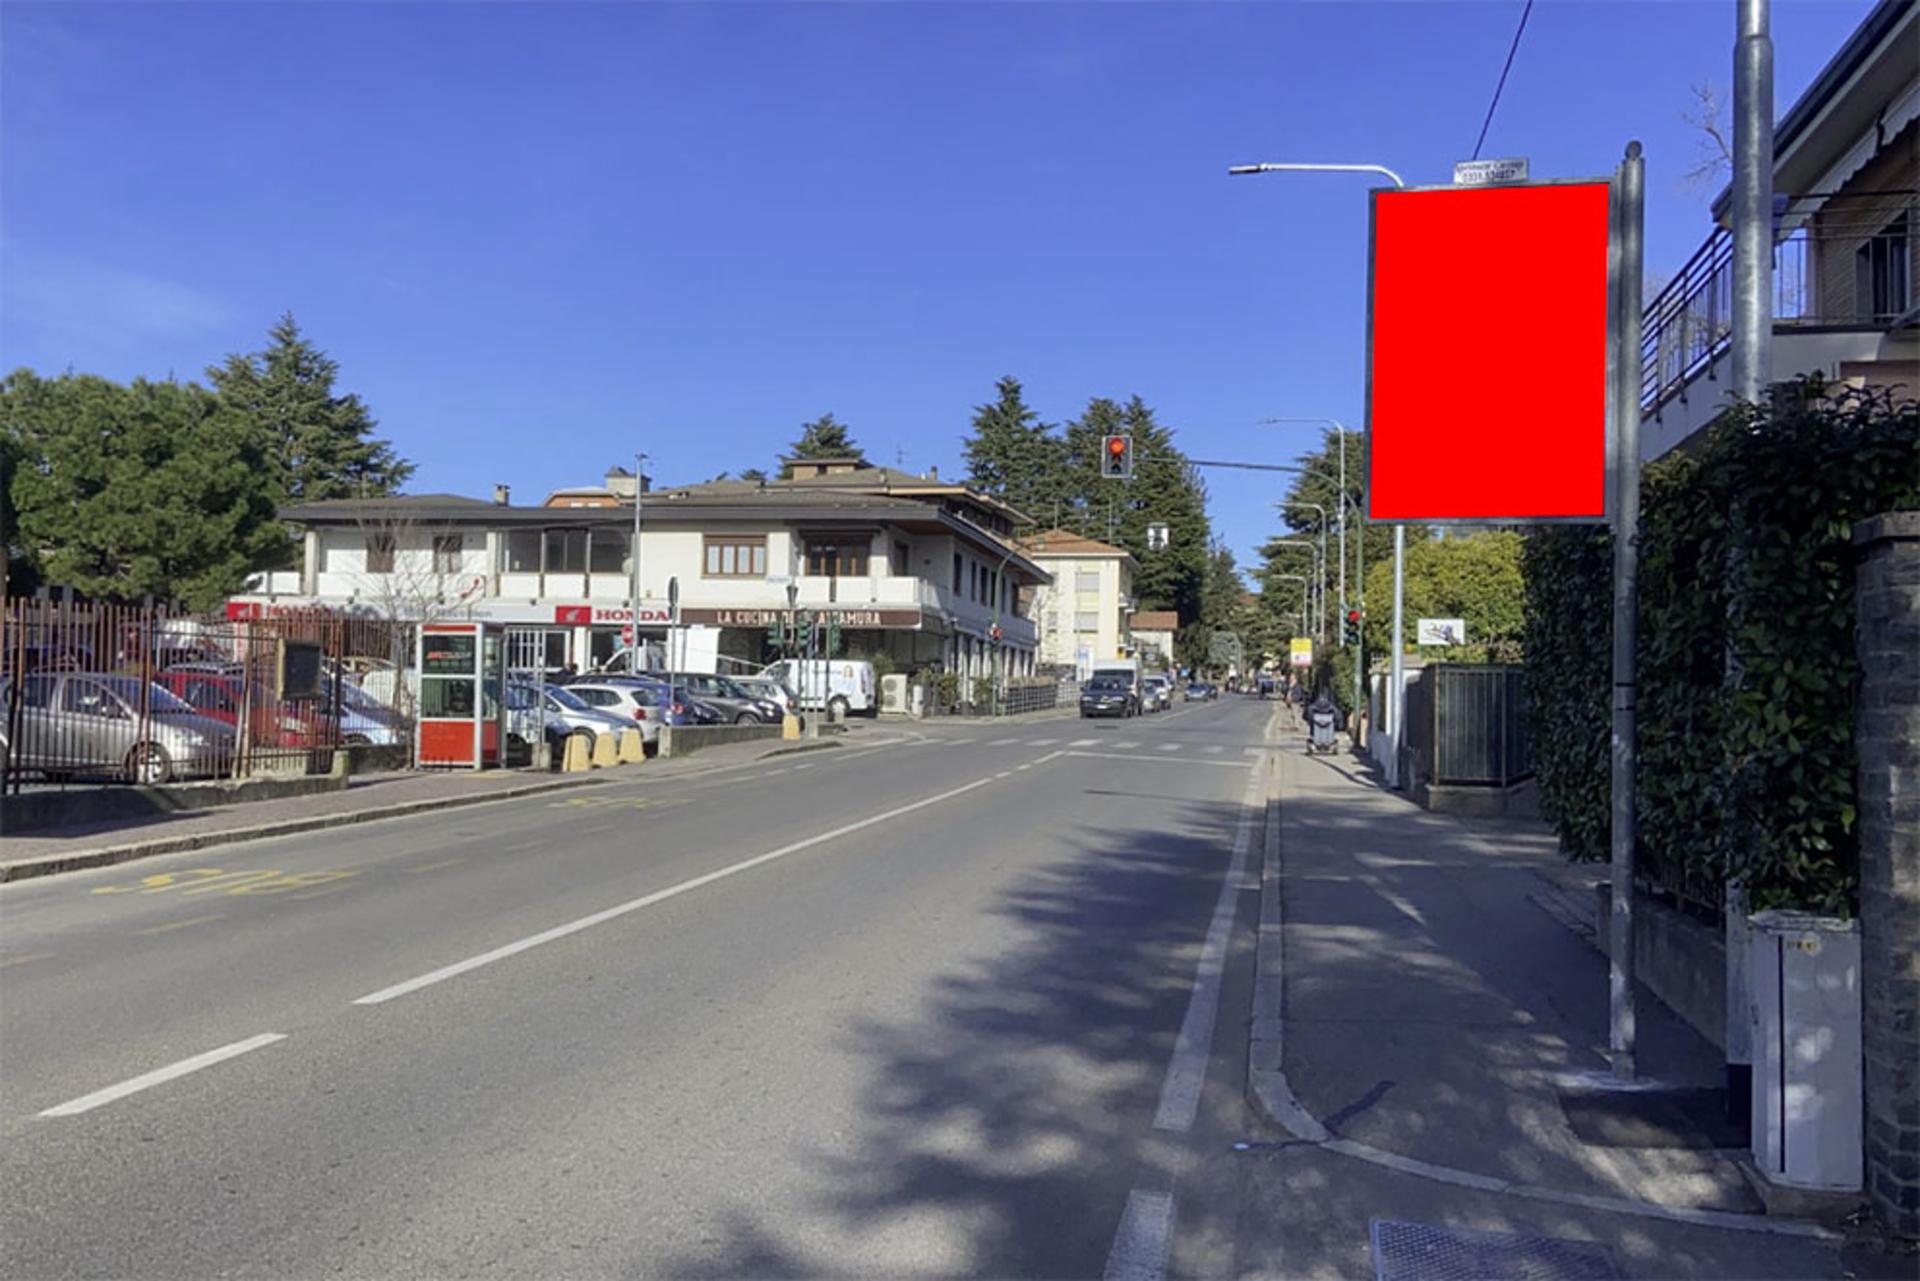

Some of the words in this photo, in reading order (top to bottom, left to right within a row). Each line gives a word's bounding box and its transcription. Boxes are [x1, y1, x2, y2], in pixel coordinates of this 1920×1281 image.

[596, 609, 669, 621] HONDA
[717, 610, 733, 625] LA
[735, 610, 777, 626] CUCINA
[817, 610, 881, 626] ATAMURA
